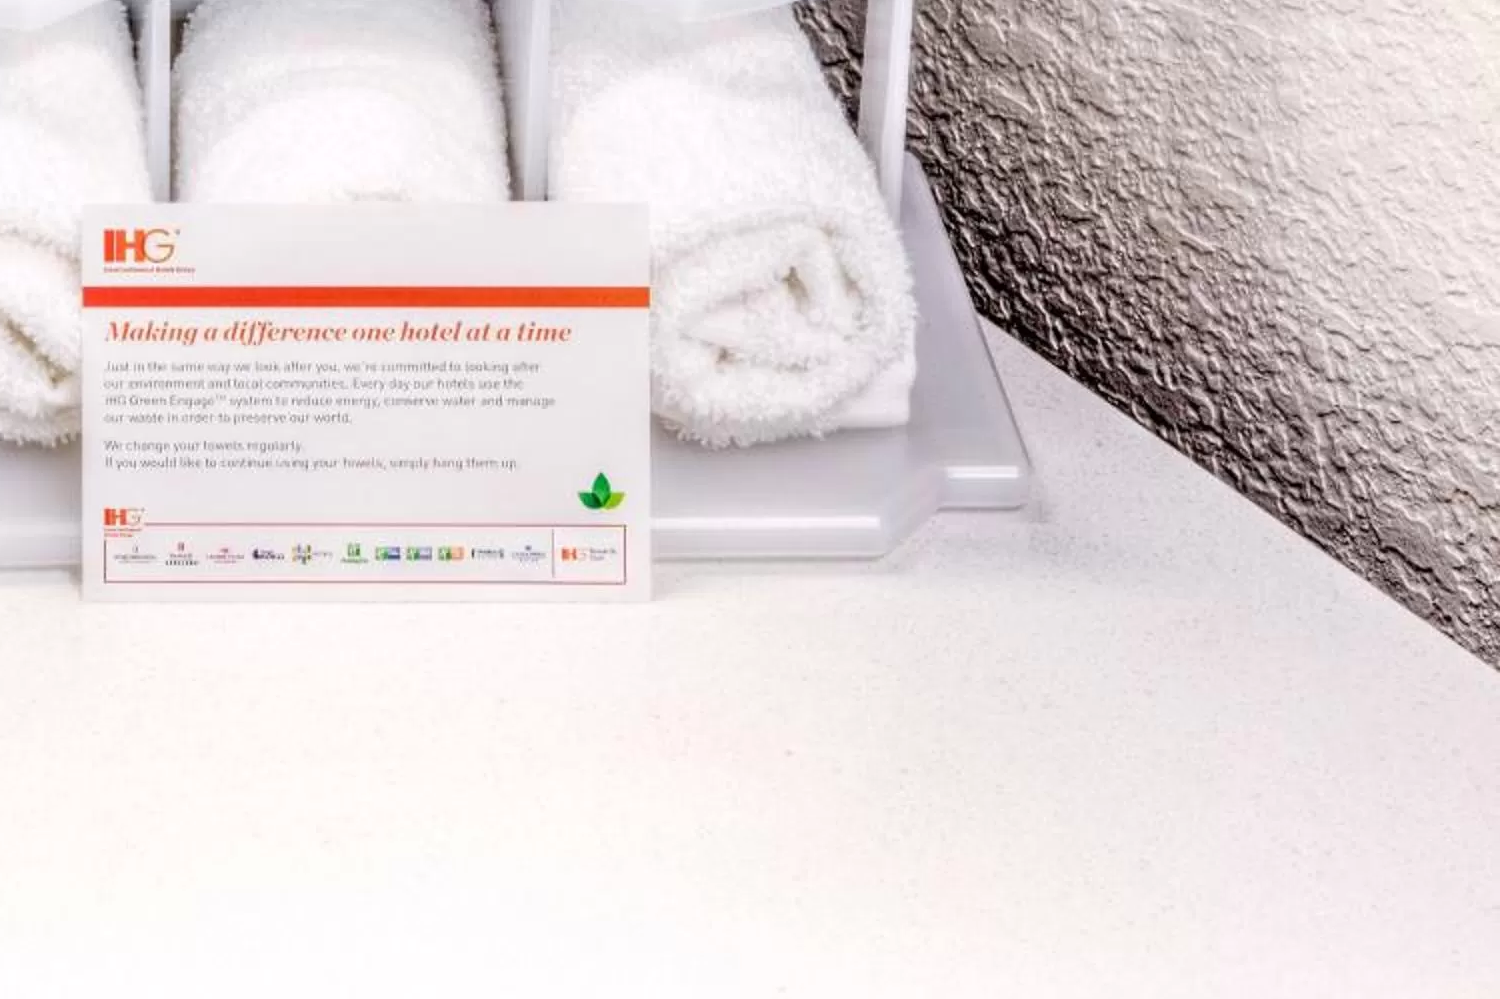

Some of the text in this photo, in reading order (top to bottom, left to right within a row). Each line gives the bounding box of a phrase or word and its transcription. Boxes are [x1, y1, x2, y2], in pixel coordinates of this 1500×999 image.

[105, 321, 571, 347] Making a difference one hotel at a time
